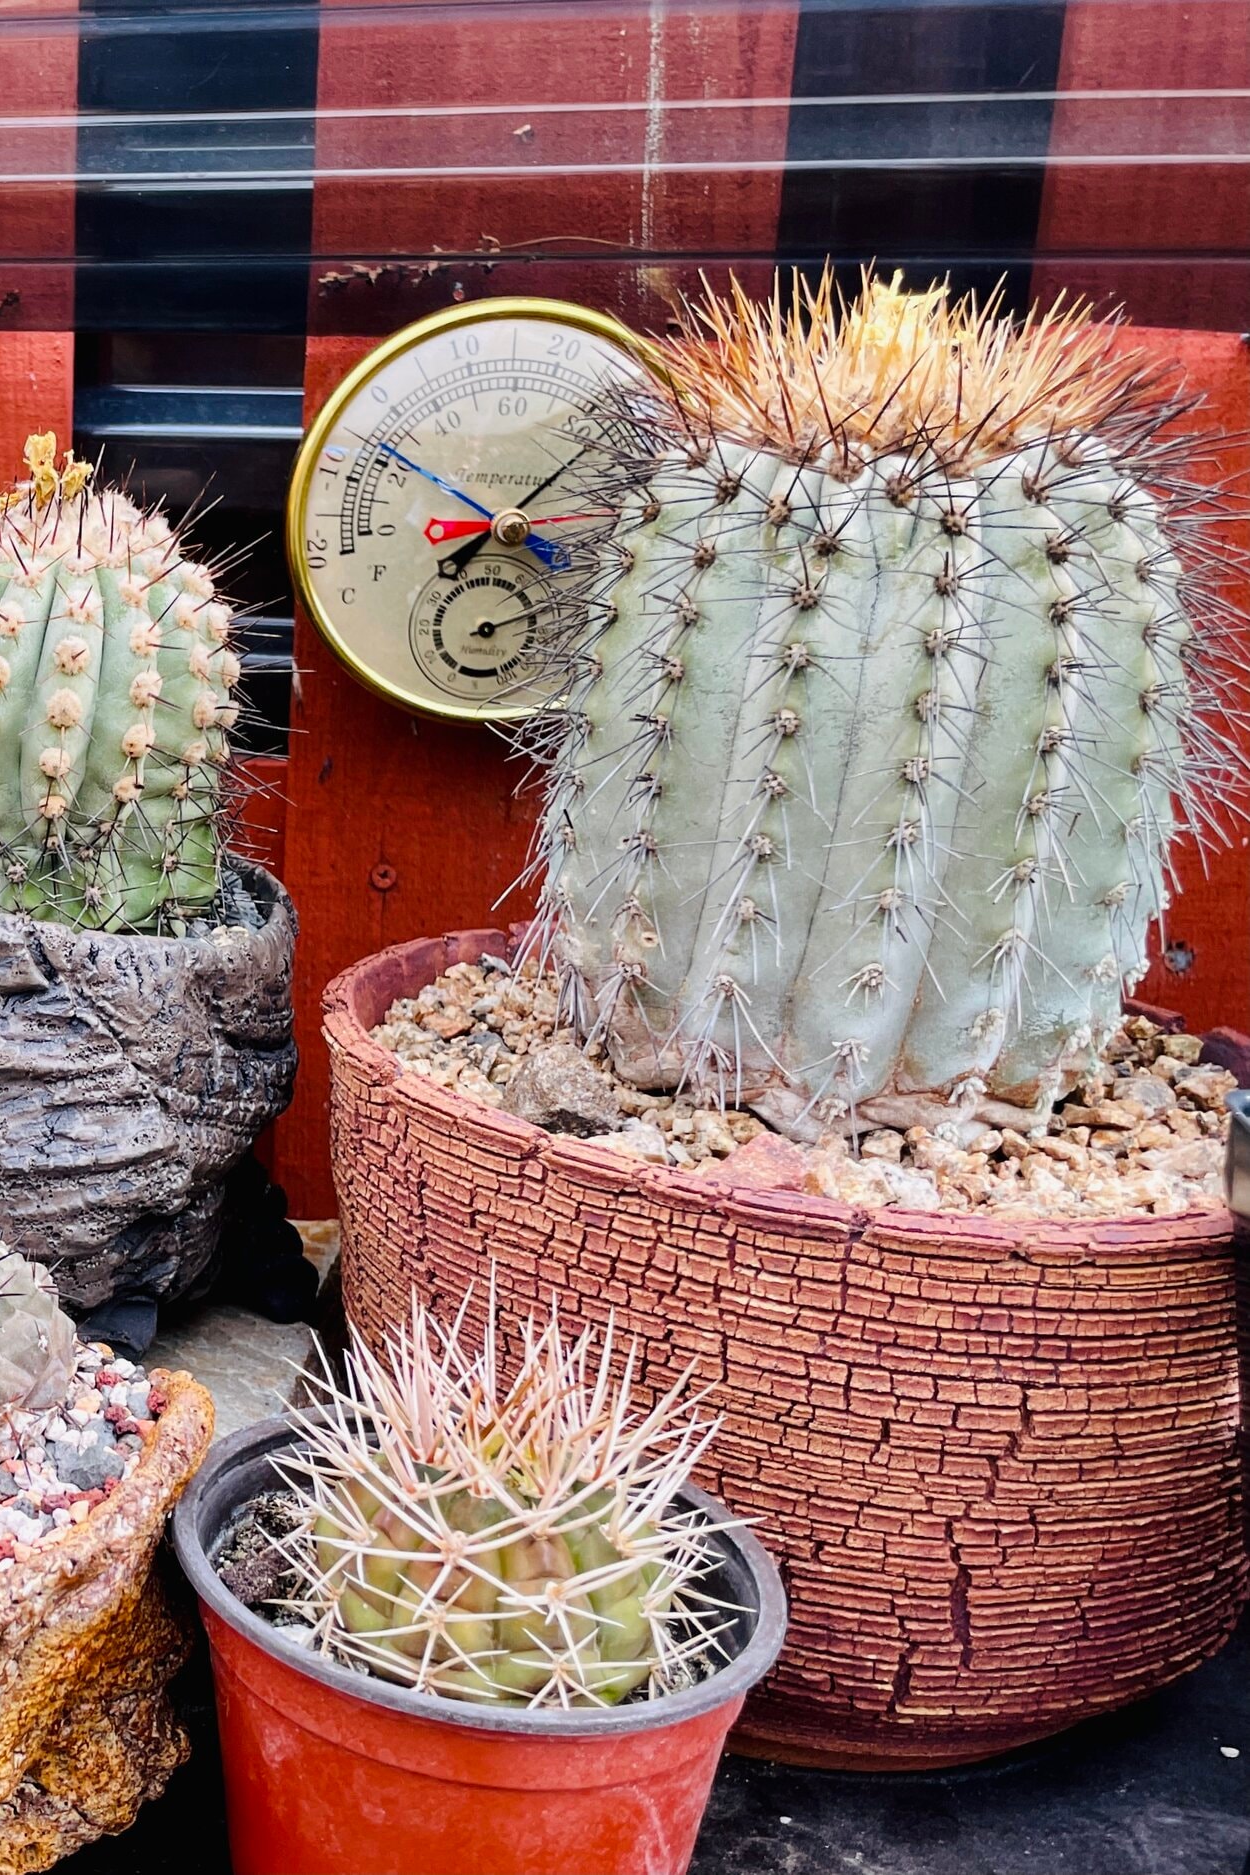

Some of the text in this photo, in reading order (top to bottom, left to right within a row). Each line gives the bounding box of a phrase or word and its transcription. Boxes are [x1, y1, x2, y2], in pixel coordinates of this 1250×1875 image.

[449, 334, 480, 361] 10
[546, 333, 582, 361] 20
[370, 385, 389, 404] 0
[498, 396, 528, 417] 60
[434, 410, 461, 438] 40
[454, 465, 552, 489] Temperatu
[376, 523, 397, 537] 0
[306, 529, 328, 570] -20
[484, 564, 502, 576] 50
[426, 590, 442, 607] 30
[418, 618, 431, 636] 20
[446, 671, 457, 683] 0
